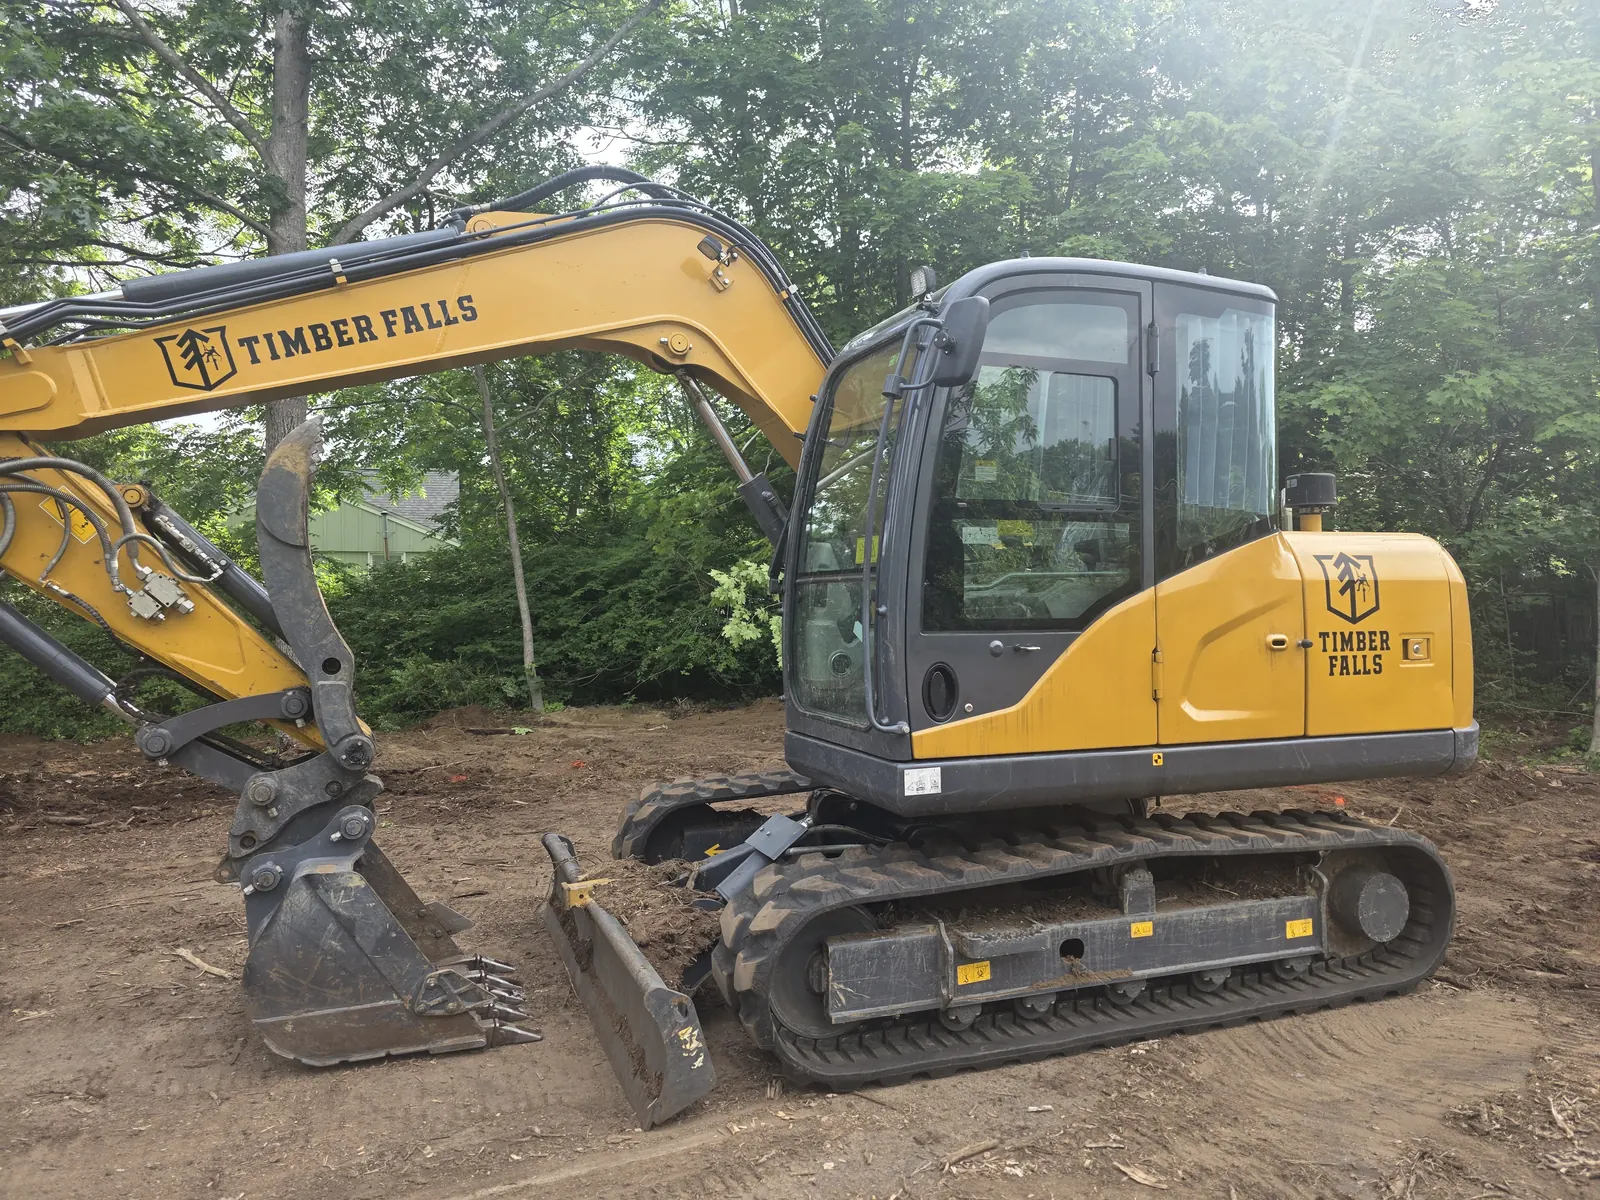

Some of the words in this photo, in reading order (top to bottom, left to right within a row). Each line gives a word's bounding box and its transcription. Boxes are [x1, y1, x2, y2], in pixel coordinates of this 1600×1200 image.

[238, 314, 378, 365] TIMBER
[380, 295, 478, 338] FALLS
[1318, 630, 1391, 653] TIMBER
[1328, 654, 1383, 677] FALLS
